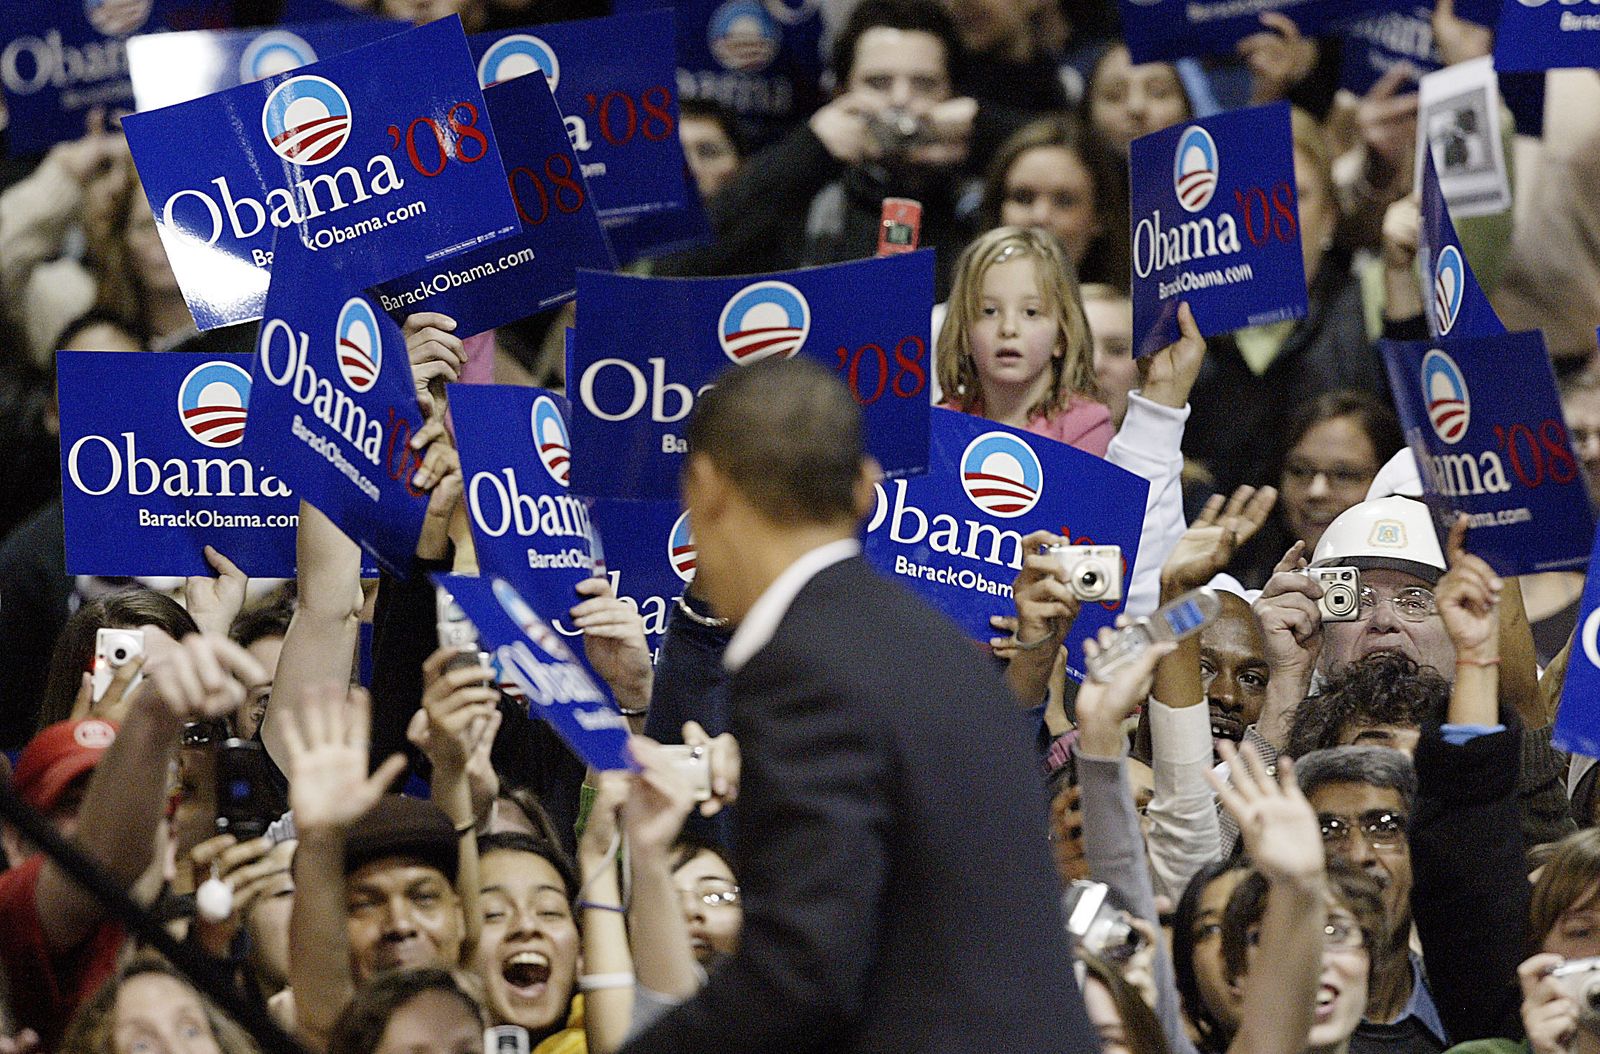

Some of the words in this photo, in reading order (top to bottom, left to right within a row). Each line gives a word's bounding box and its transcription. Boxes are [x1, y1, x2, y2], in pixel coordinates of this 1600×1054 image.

[163, 154, 405, 248] Obama
[387, 101, 489, 177] '08
[251, 200, 427, 268] BakObama.com
[1133, 209, 1242, 279] Obama
[1234, 180, 1297, 249] '08
[380, 247, 536, 313] BarackObama.com
[1158, 263, 1254, 300] BarackObama.com
[260, 318, 383, 466] Obama
[835, 335, 926, 406] '08
[67, 431, 293, 498] Obama
[1493, 418, 1578, 490] '08
